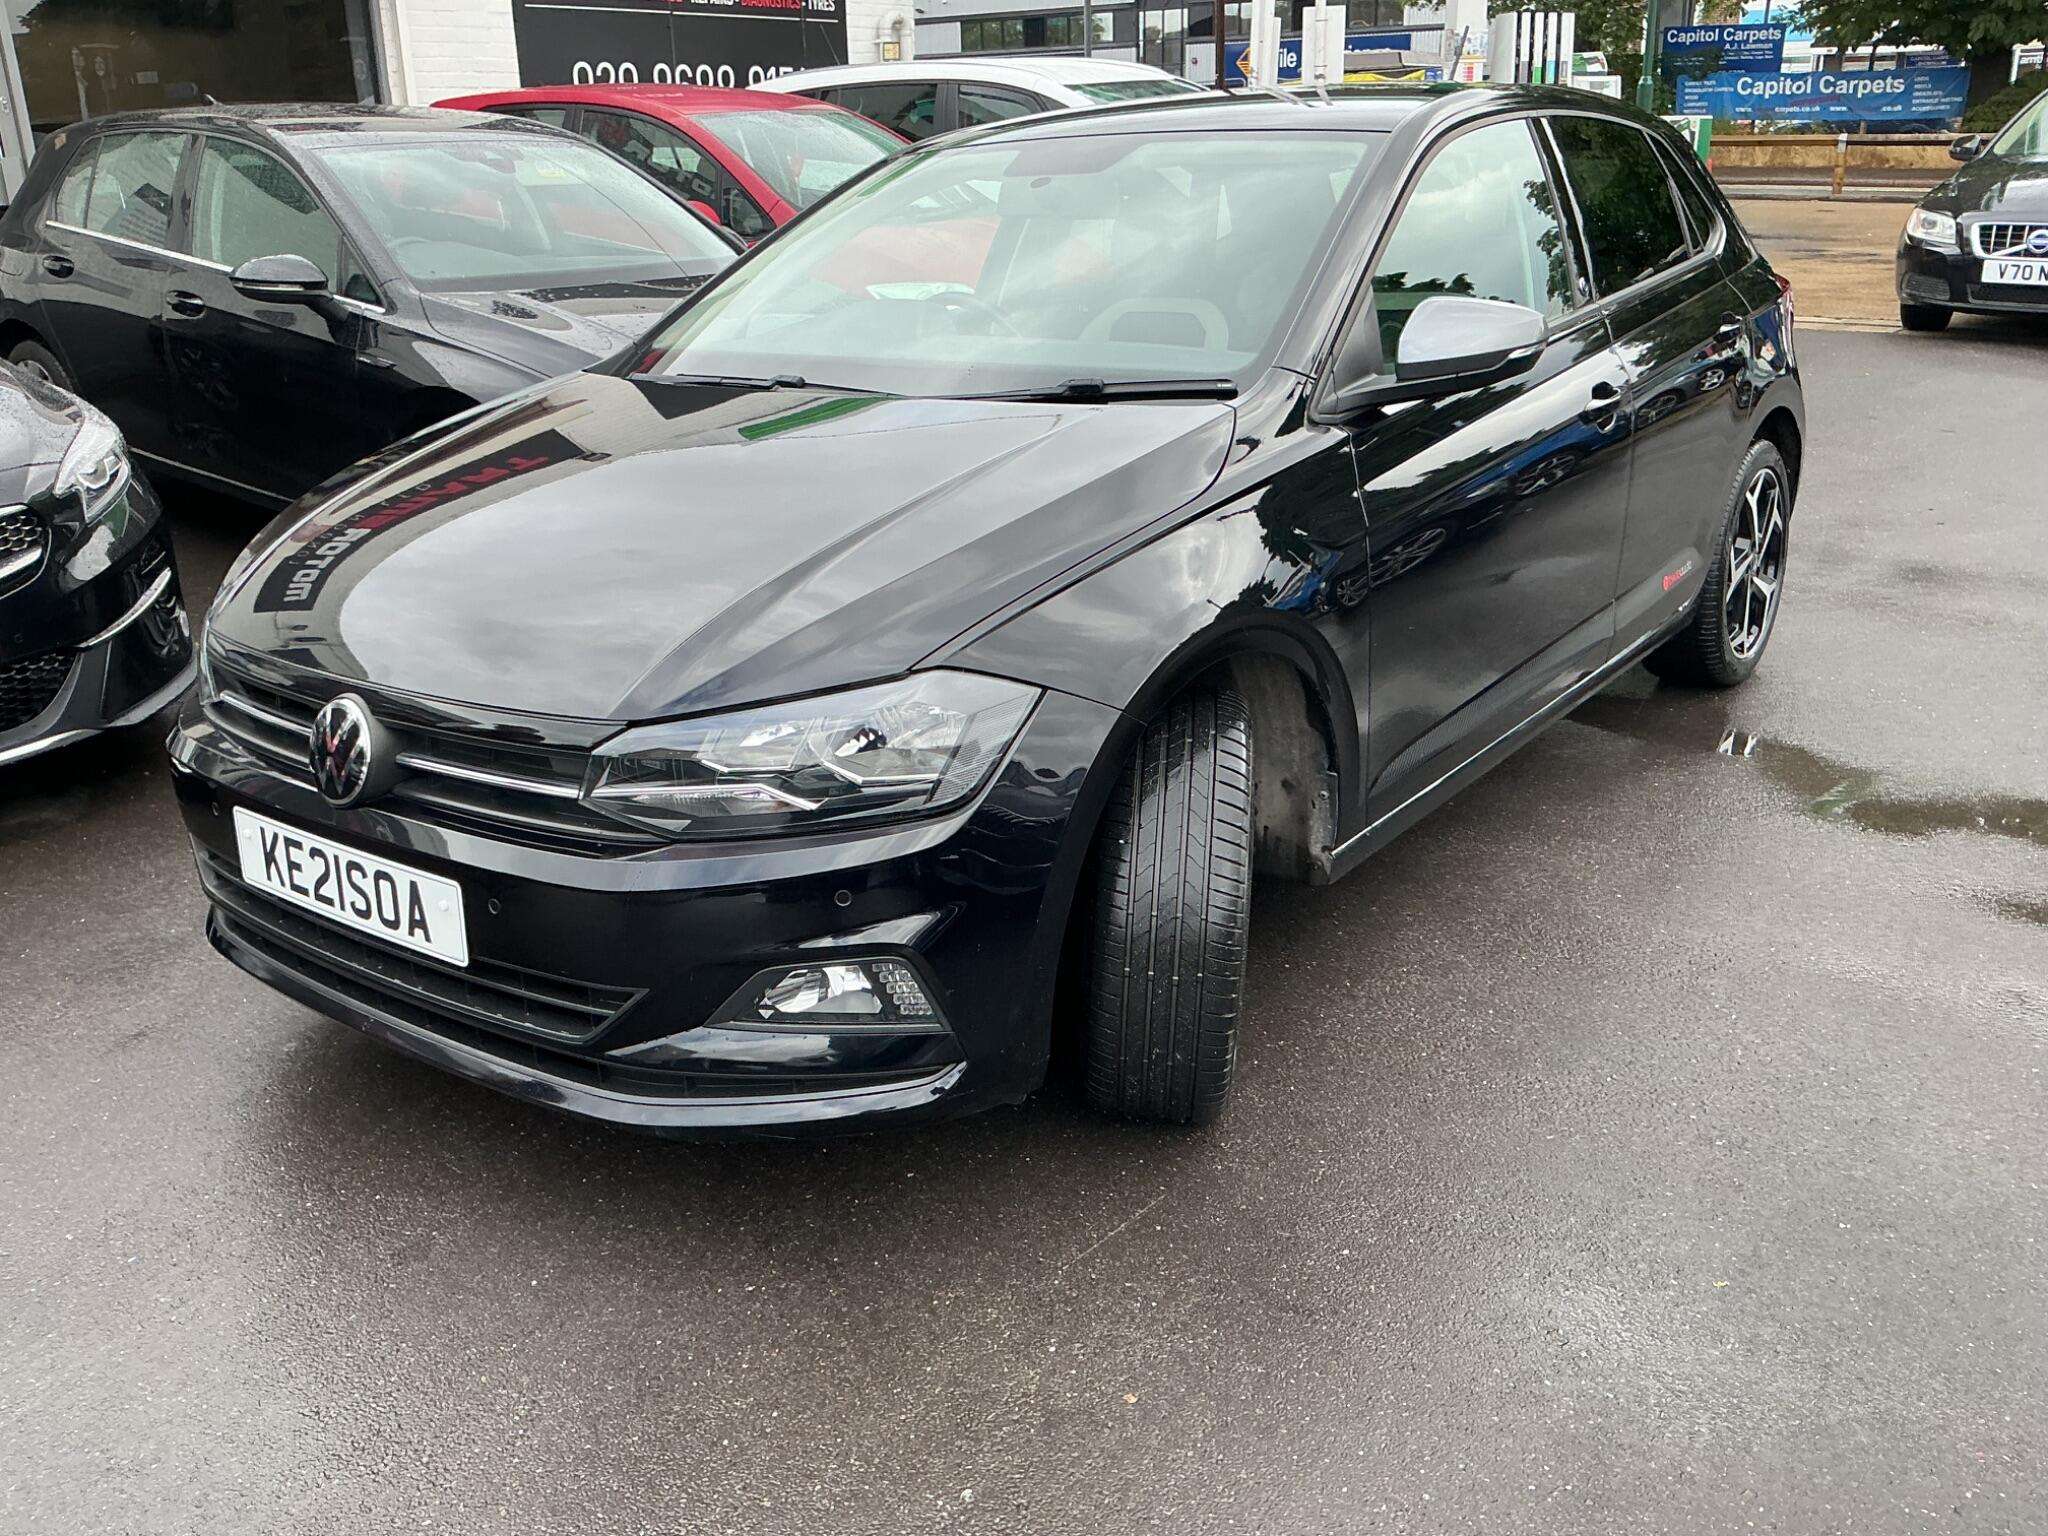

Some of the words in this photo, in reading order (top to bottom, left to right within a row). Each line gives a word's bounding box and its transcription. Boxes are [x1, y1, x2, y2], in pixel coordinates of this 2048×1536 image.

[1667, 28, 1719, 45] Capitol
[1723, 26, 1782, 43] Carpets
[1737, 76, 1812, 98] Capitol
[1819, 75, 1905, 98] Carpets
[1999, 264, 2034, 280] V70
